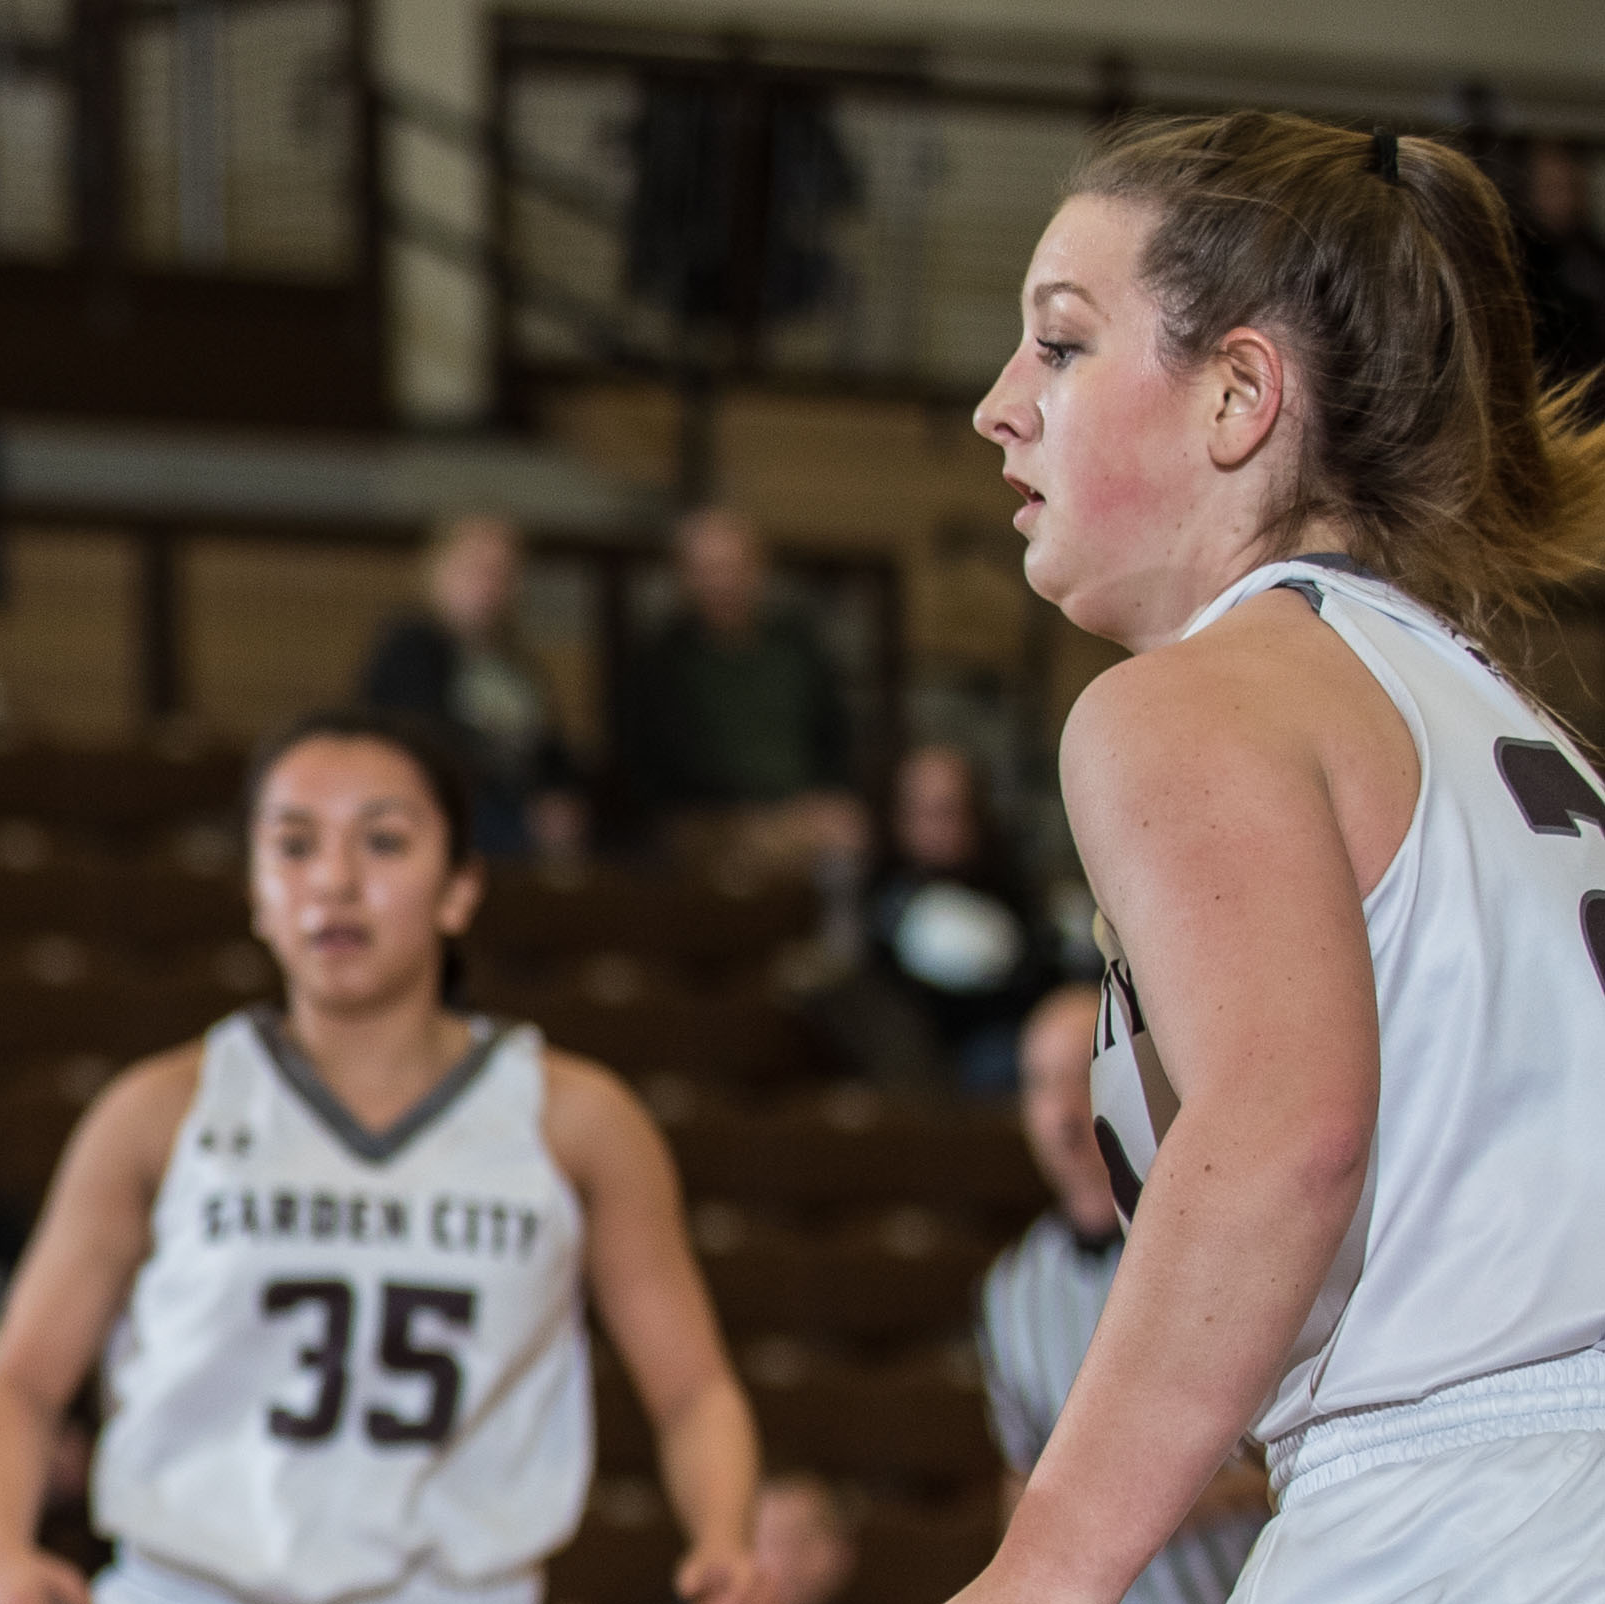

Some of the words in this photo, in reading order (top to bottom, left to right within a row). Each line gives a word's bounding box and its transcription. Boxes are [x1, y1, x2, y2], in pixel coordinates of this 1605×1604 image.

[202, 1190, 409, 1244] GARDEN
[431, 1196, 540, 1262] CITY
[263, 1278, 478, 1446] 35
